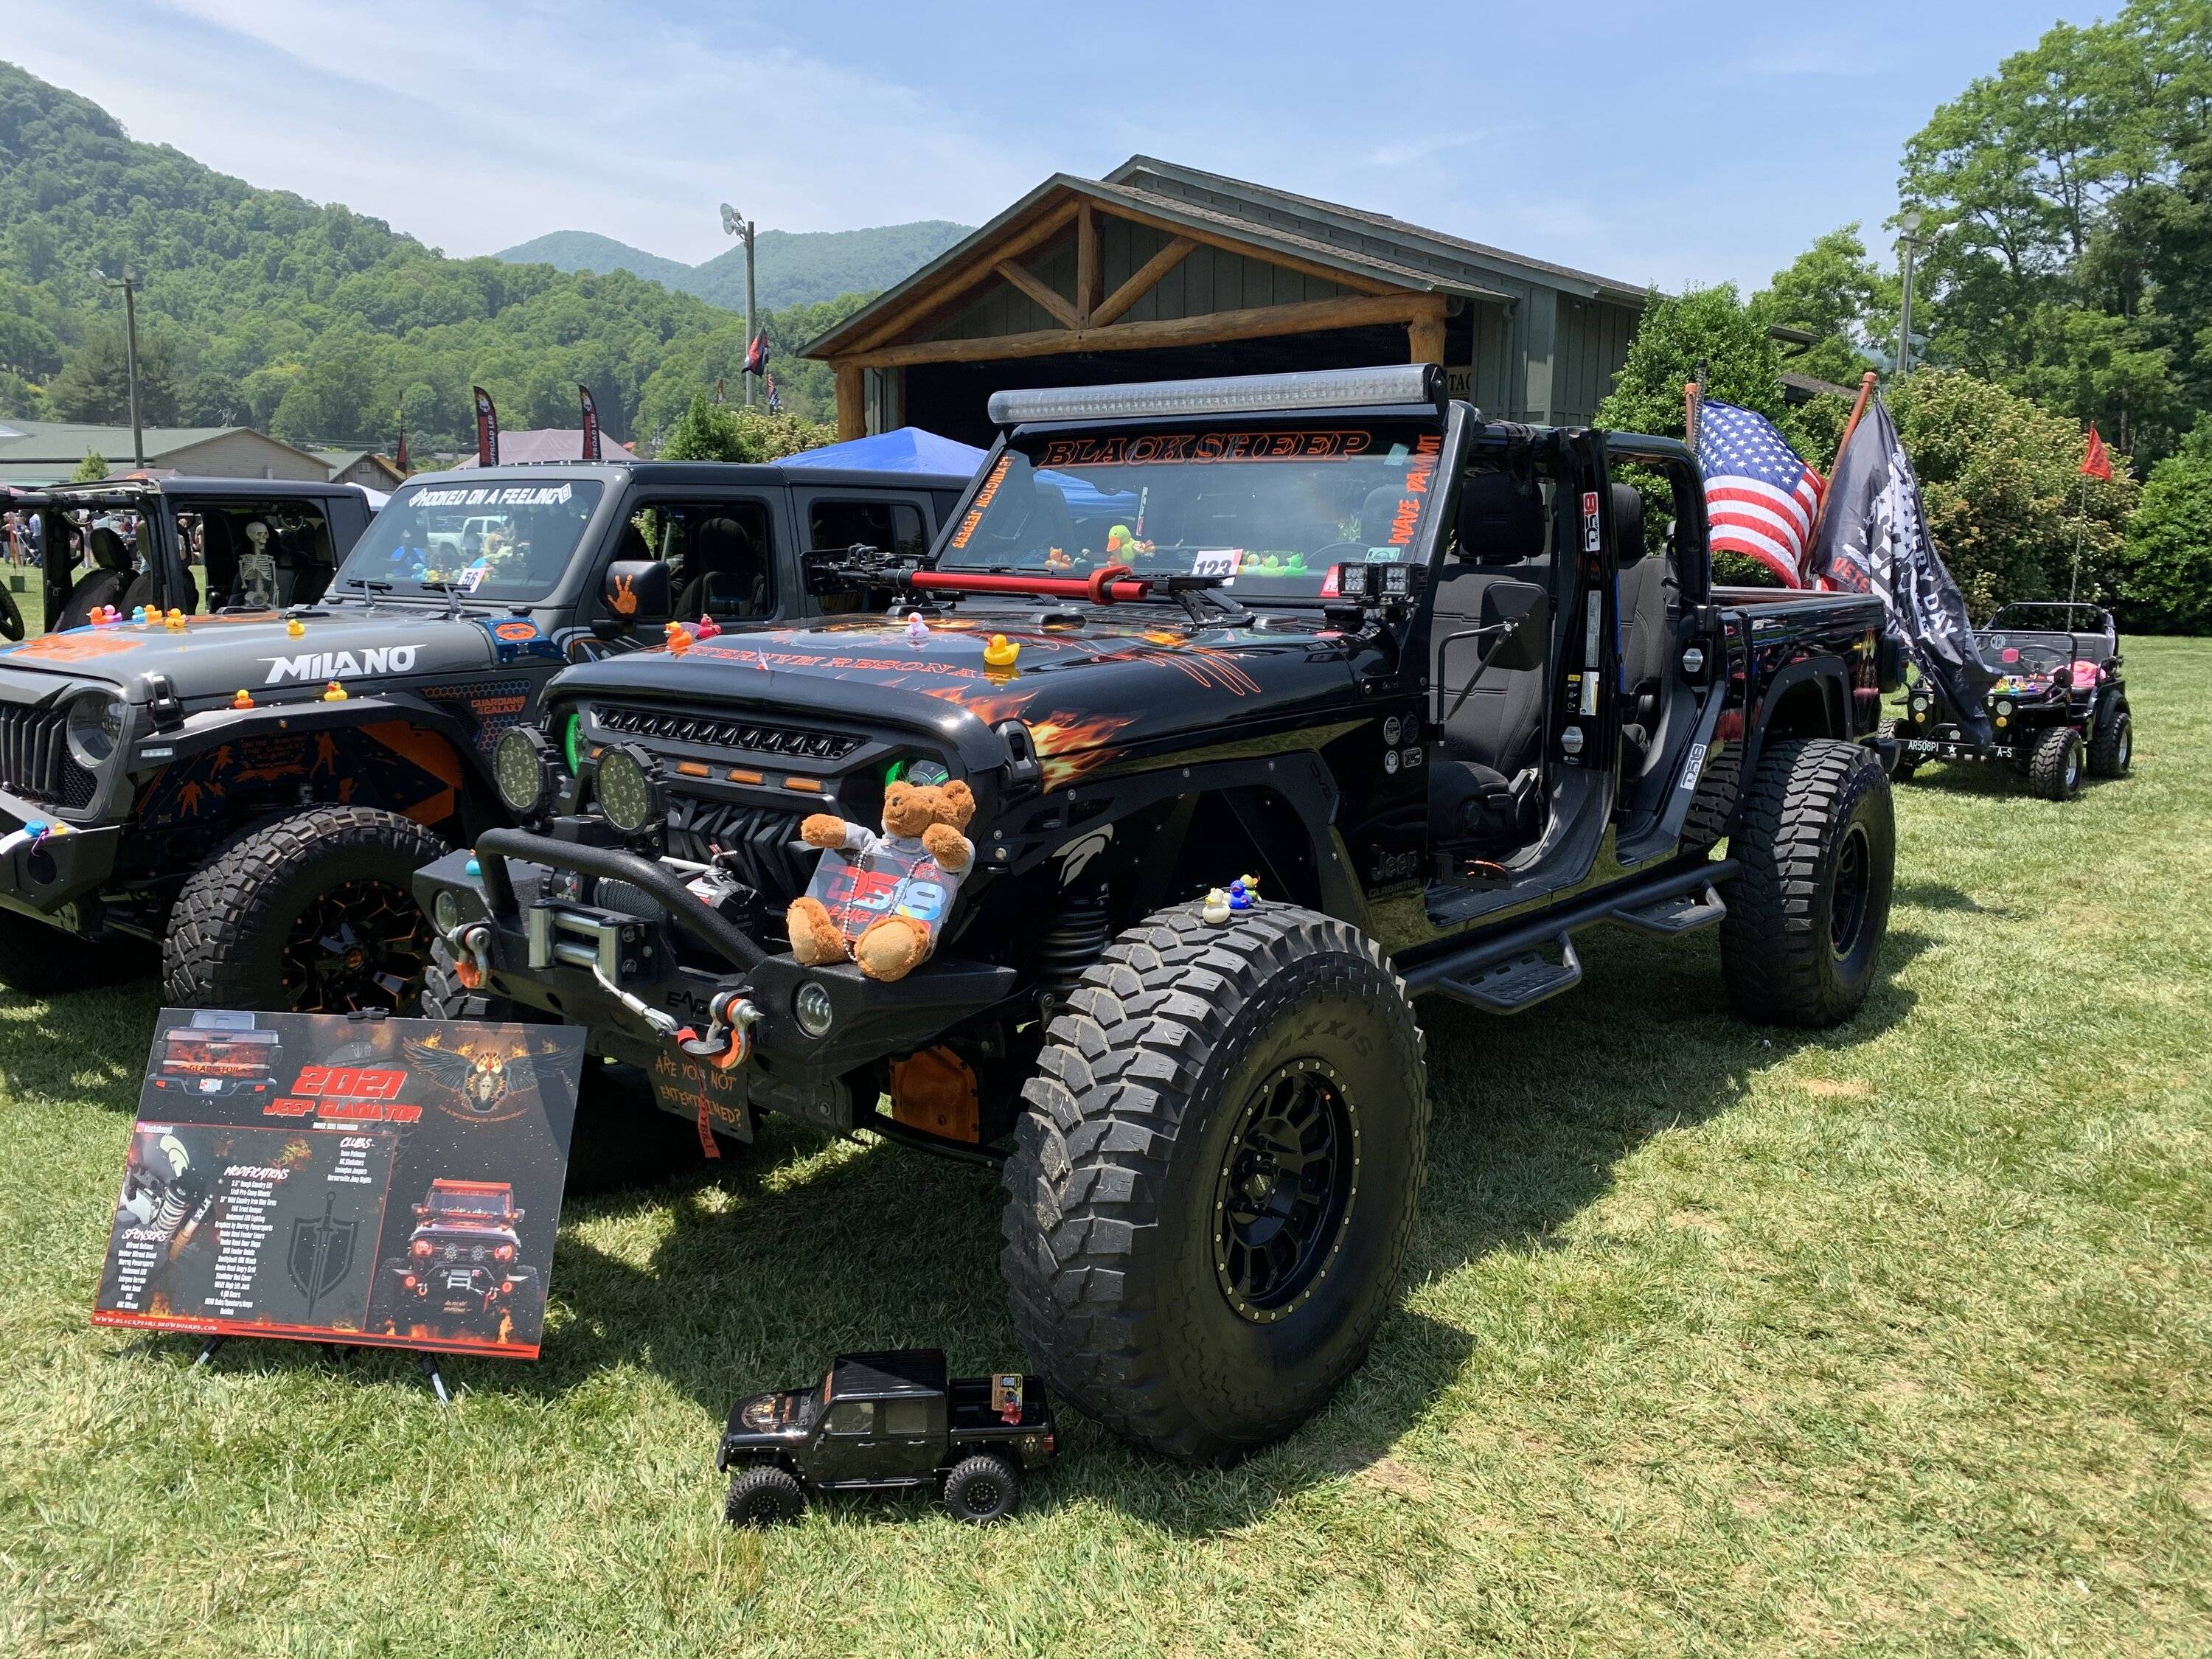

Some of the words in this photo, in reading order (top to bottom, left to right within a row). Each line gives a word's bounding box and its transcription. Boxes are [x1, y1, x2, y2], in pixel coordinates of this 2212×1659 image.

[1191, 430, 1371, 464] SHEEP
[417, 489, 468, 507] HOOKED
[465, 488, 489, 505] ON
[484, 488, 500, 505] A
[498, 487, 562, 505] FEELING
[974, 454, 1015, 508] LEXINGTON
[952, 509, 983, 549] JEEPERS
[1388, 498, 1421, 544] WAVE
[462, 571, 479, 585] 56
[1196, 560, 1232, 576] 123
[1832, 555, 1871, 593] VETE
[1923, 590, 1959, 639] DAY
[256, 644, 429, 684] MILANO
[471, 695, 526, 709] GUARDIANS
[484, 703, 524, 714] GALAXY
[1371, 849, 1418, 882] Jeep
[1368, 877, 1421, 898] GLADIATOR
[291, 1065, 408, 1100] 2021
[655, 1055, 678, 1077] ARE
[711, 1071, 737, 1092] NOT
[262, 1098, 316, 1117] JEEP
[317, 1100, 422, 1124] GLADIATOR
[659, 1085, 742, 1128] ENTERTINED?
[340, 1136, 372, 1149] CLUBS
[223, 1165, 290, 1180] MODIFICATIONS
